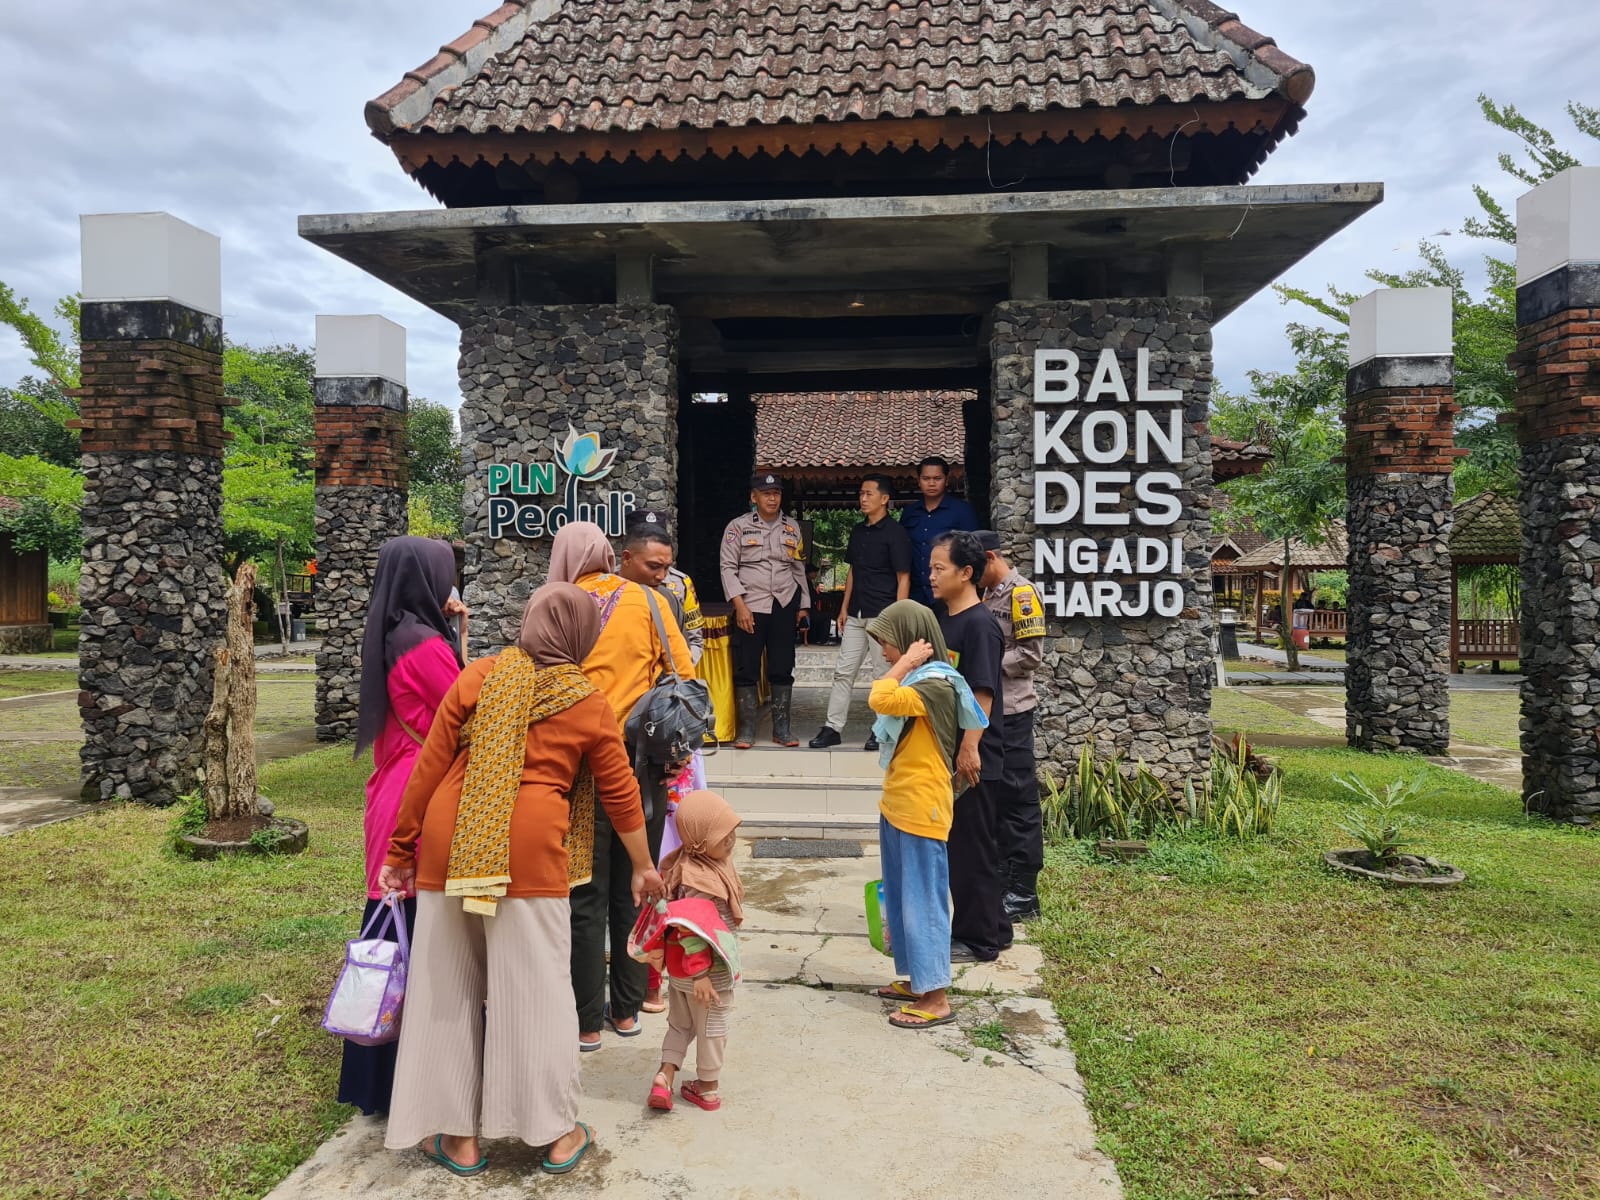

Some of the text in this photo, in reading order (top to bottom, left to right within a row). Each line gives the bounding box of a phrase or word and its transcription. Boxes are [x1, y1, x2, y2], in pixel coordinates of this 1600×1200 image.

[1034, 348, 1183, 401] BAL
[1034, 409, 1183, 464] KON
[488, 463, 556, 495] PLN
[1034, 471, 1182, 525] DES
[1035, 538, 1183, 574] NGADI
[1038, 581, 1184, 617] HARJO
